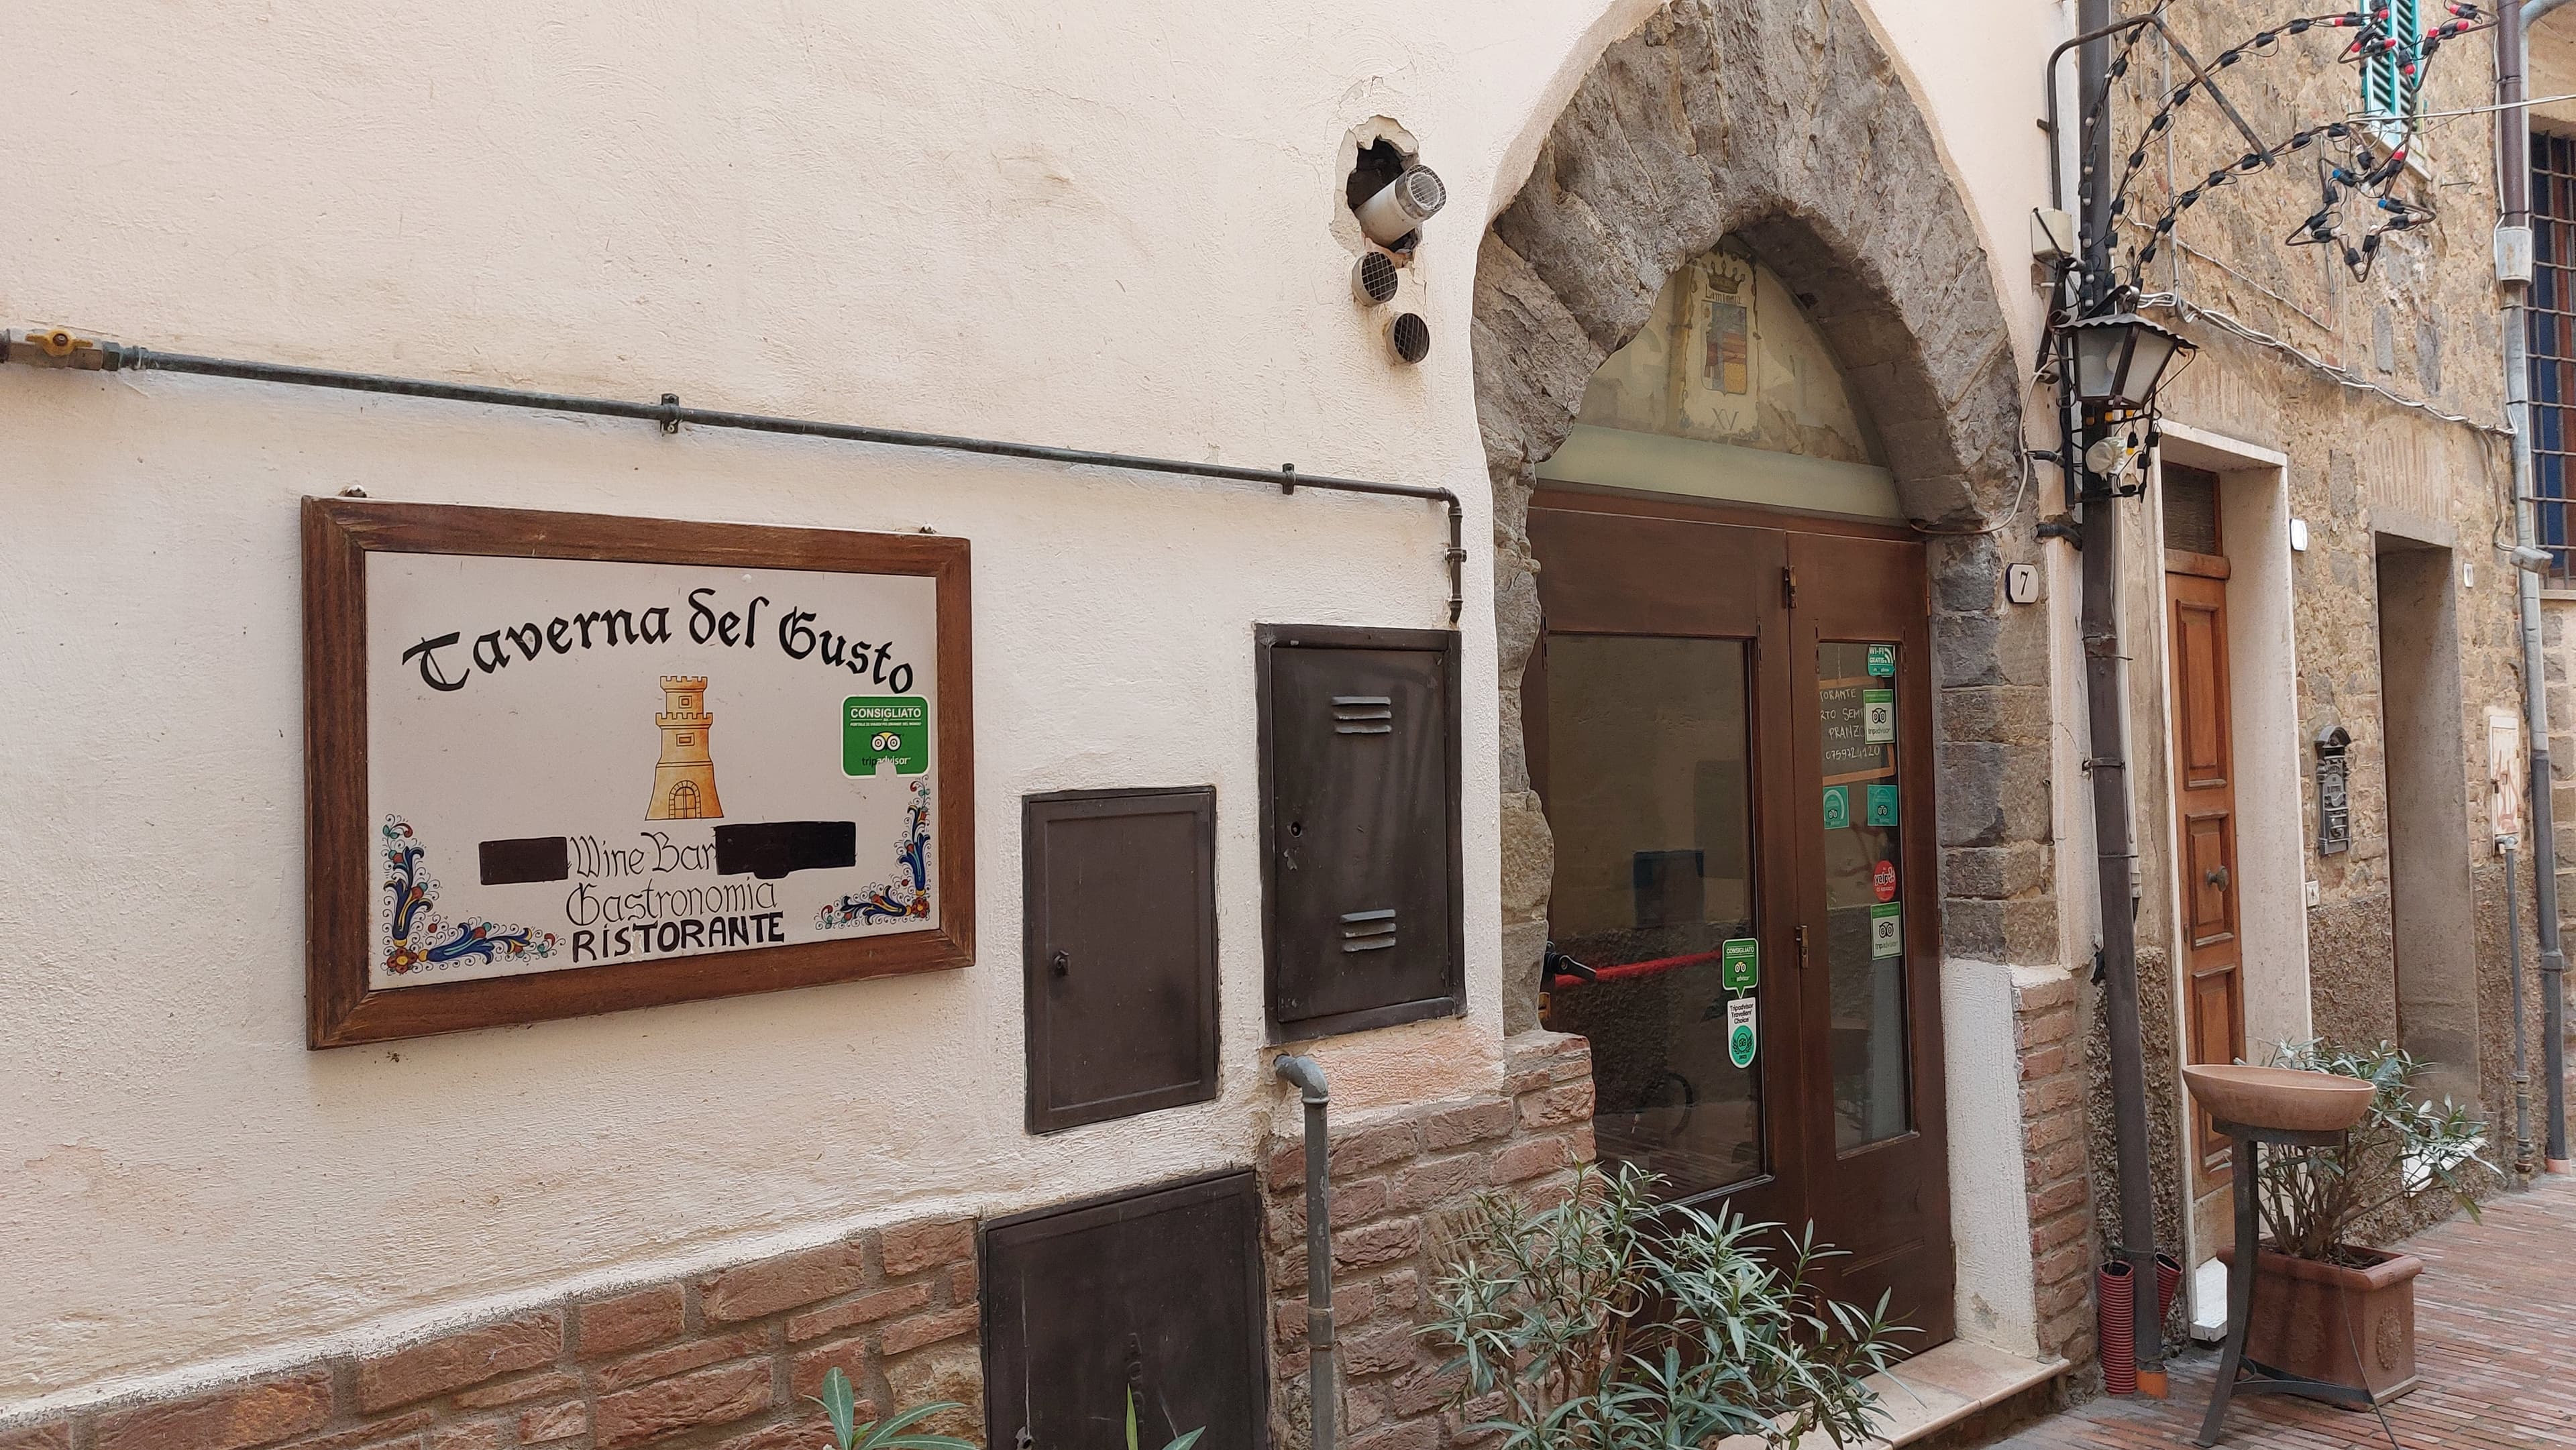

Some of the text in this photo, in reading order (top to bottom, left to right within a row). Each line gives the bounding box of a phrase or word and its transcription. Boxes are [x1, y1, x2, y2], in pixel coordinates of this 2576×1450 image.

[1711, 407, 1739, 431] XV
[2020, 571, 2029, 596] 7
[402, 588, 914, 694] Taverna del Gusto
[1868, 647, 1884, 655] WI-FI
[850, 708, 922, 719] CONSIGLIATO
[570, 832, 716, 877] Wine Bar
[1874, 872, 1888, 886] yelp
[566, 876, 777, 926] Gastronomia
[1730, 1003, 1754, 1012] Tripadvisor
